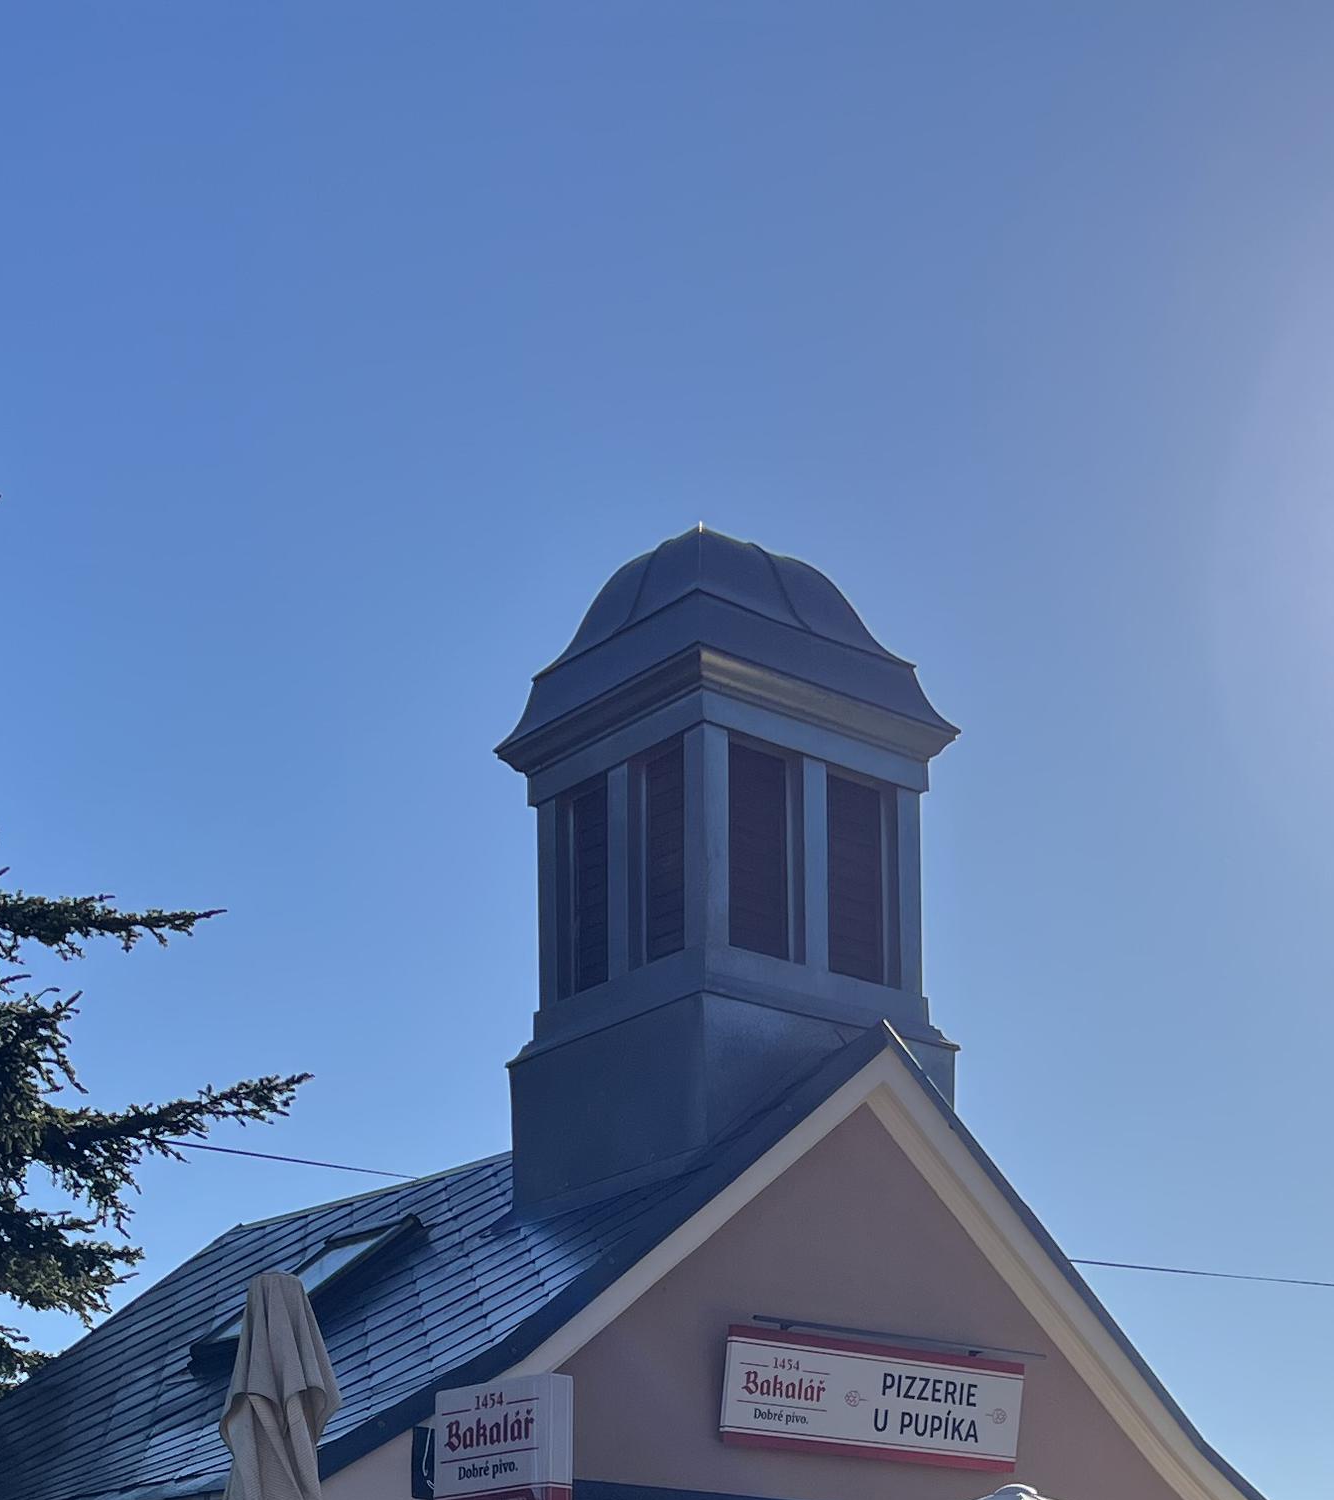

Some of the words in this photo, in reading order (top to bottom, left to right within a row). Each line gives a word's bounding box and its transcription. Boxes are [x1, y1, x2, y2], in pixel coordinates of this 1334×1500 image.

[772, 1357, 800, 1371] 1454
[742, 1370, 826, 1403] Bakalář
[881, 1372, 978, 1407] PIZZERIE
[475, 1392, 503, 1410] 1454
[754, 1408, 783, 1422] Dobré
[785, 1411, 809, 1425] pivo.
[874, 1408, 889, 1433] U
[899, 1409, 979, 1443] PUPÍKA
[444, 1409, 534, 1452] Bakalář
[458, 1461, 489, 1480] Dobré
[493, 1459, 518, 1479] pivo.
